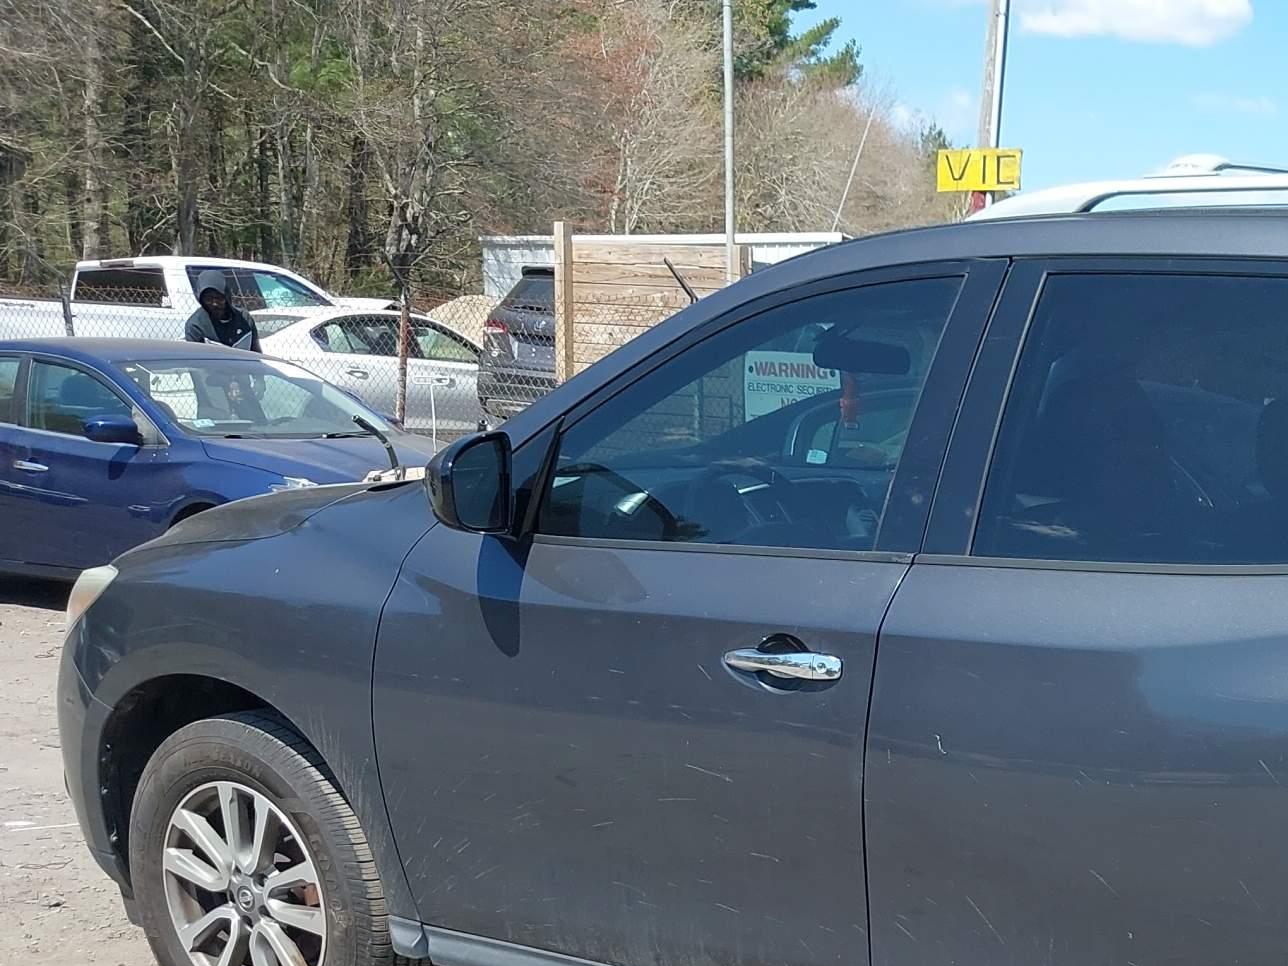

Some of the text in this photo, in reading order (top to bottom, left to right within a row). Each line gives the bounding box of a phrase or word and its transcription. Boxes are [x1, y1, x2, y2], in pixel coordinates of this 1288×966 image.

[945, 153, 1016, 185] VIC
[753, 361, 828, 380] WARNING
[747, 382, 794, 393] ELECTRONIC
